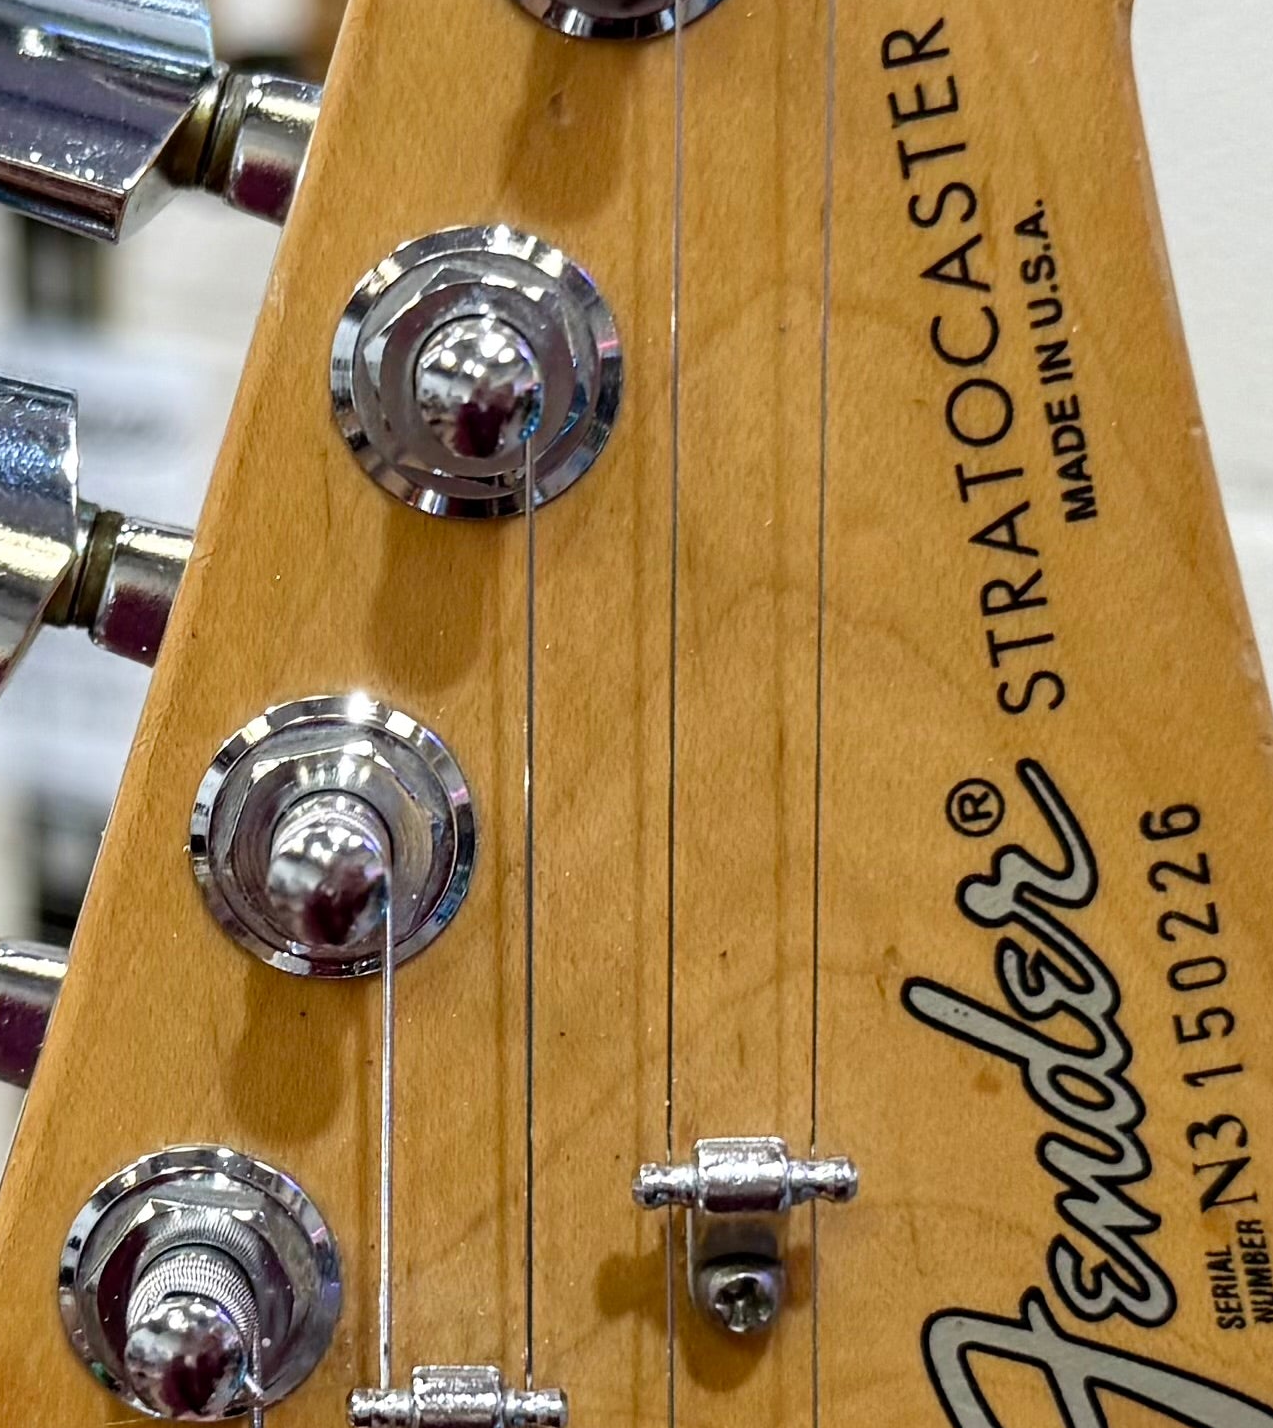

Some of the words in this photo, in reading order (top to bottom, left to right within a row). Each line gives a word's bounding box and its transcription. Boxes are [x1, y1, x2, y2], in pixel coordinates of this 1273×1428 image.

[1014, 198, 1064, 331] U.S.A.
[880, 16, 1066, 716] STRATOCASTER
[1034, 340, 1079, 386] IN
[1048, 393, 1098, 524] MADE
[1139, 802, 1260, 1214] N3150226
[1204, 1244, 1247, 1330] SERIAL
